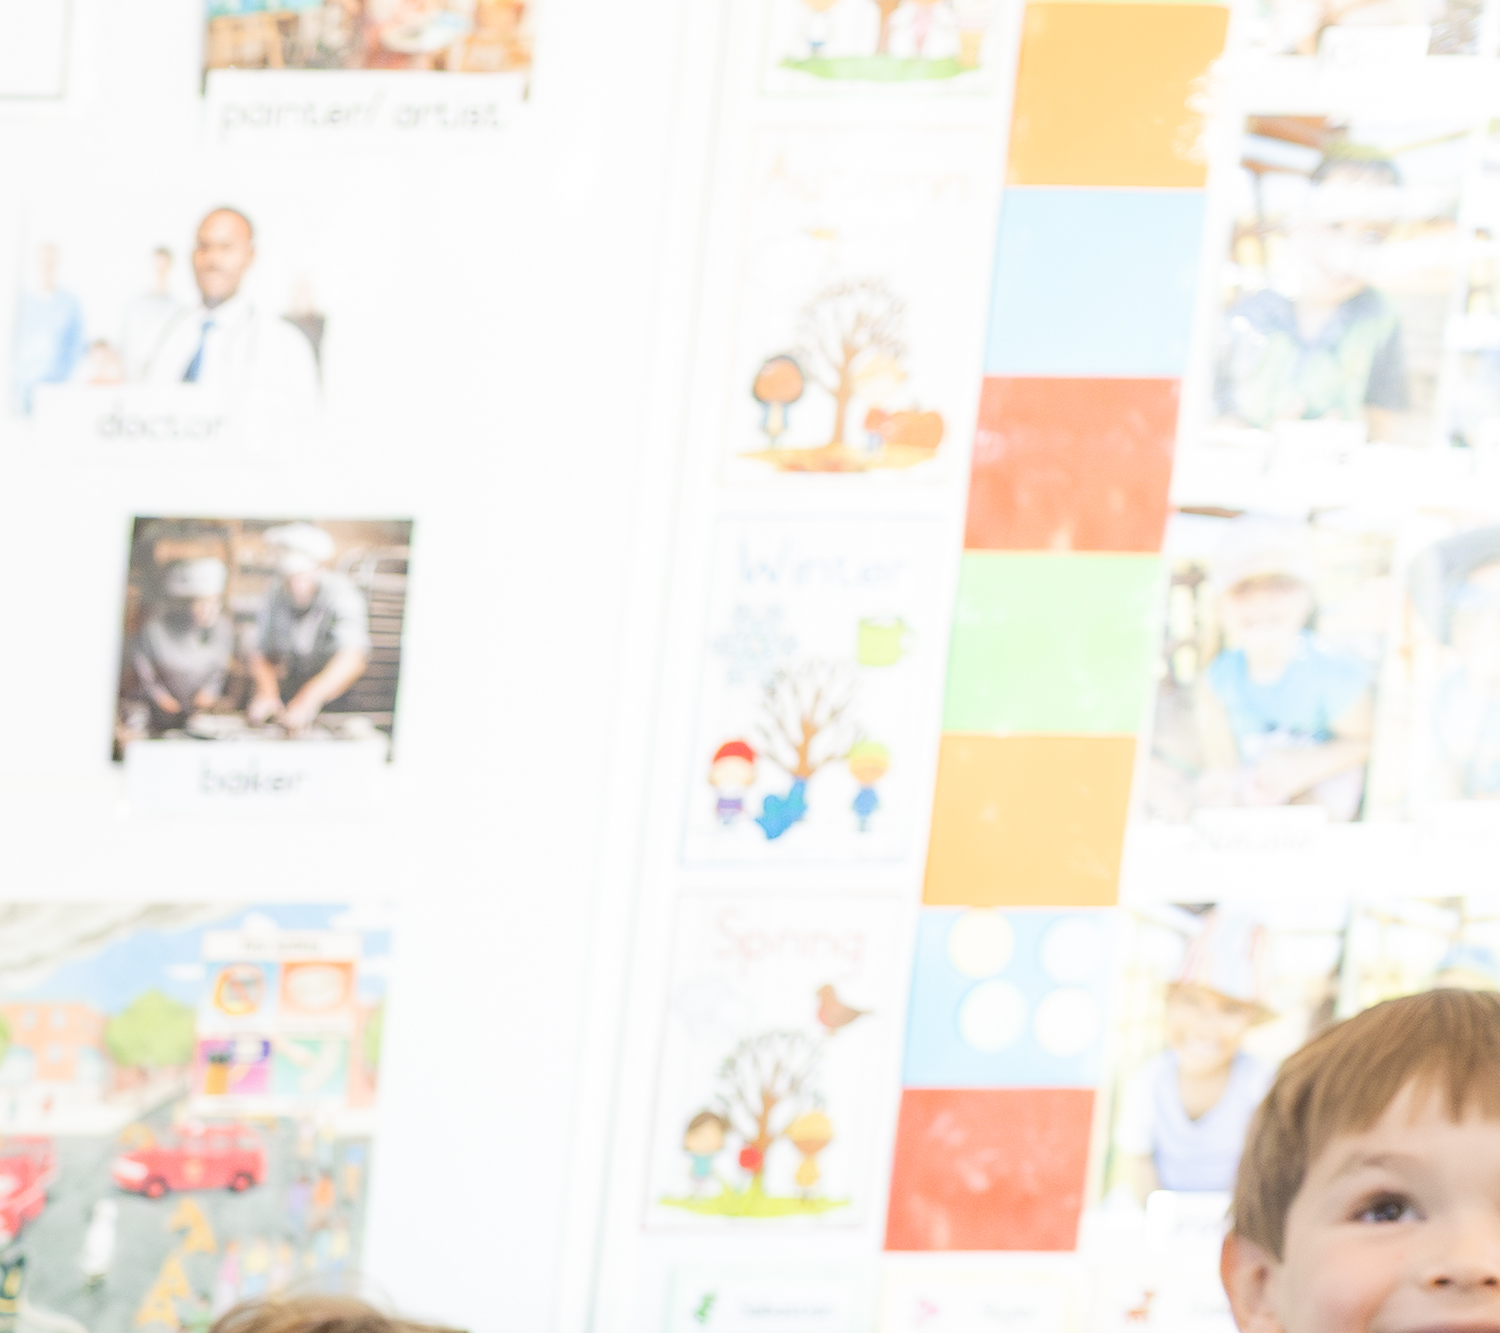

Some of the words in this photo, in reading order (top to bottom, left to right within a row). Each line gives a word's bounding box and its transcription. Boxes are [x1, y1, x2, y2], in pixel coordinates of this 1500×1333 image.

[95, 402, 226, 441] doctor
[199, 761, 304, 796] baker
[712, 903, 870, 984] Spring
